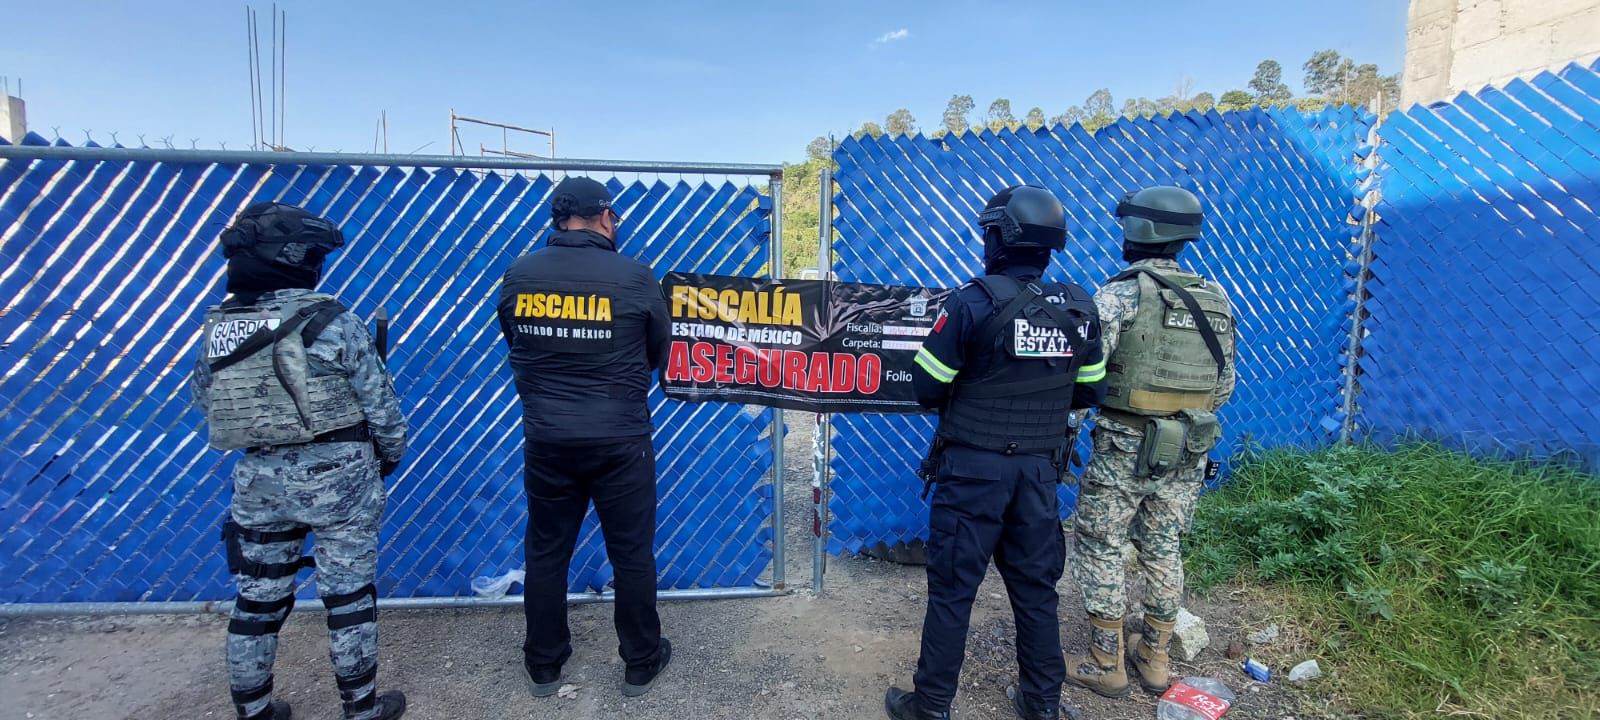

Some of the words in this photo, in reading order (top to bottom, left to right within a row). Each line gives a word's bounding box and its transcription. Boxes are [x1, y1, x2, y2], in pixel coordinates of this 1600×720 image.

[514, 293, 612, 321] FISCALÍA
[671, 285, 803, 326] FISCALÍA
[518, 324, 553, 337] ESTADO
[556, 327, 568, 337] DE
[572, 327, 612, 339] MÉXICO
[671, 322, 724, 339] ESTADO
[727, 327, 745, 341] DE
[747, 327, 802, 345] MÉXICO
[842, 338, 880, 350] Carpeta:
[665, 341, 882, 394] ASEGURADO
